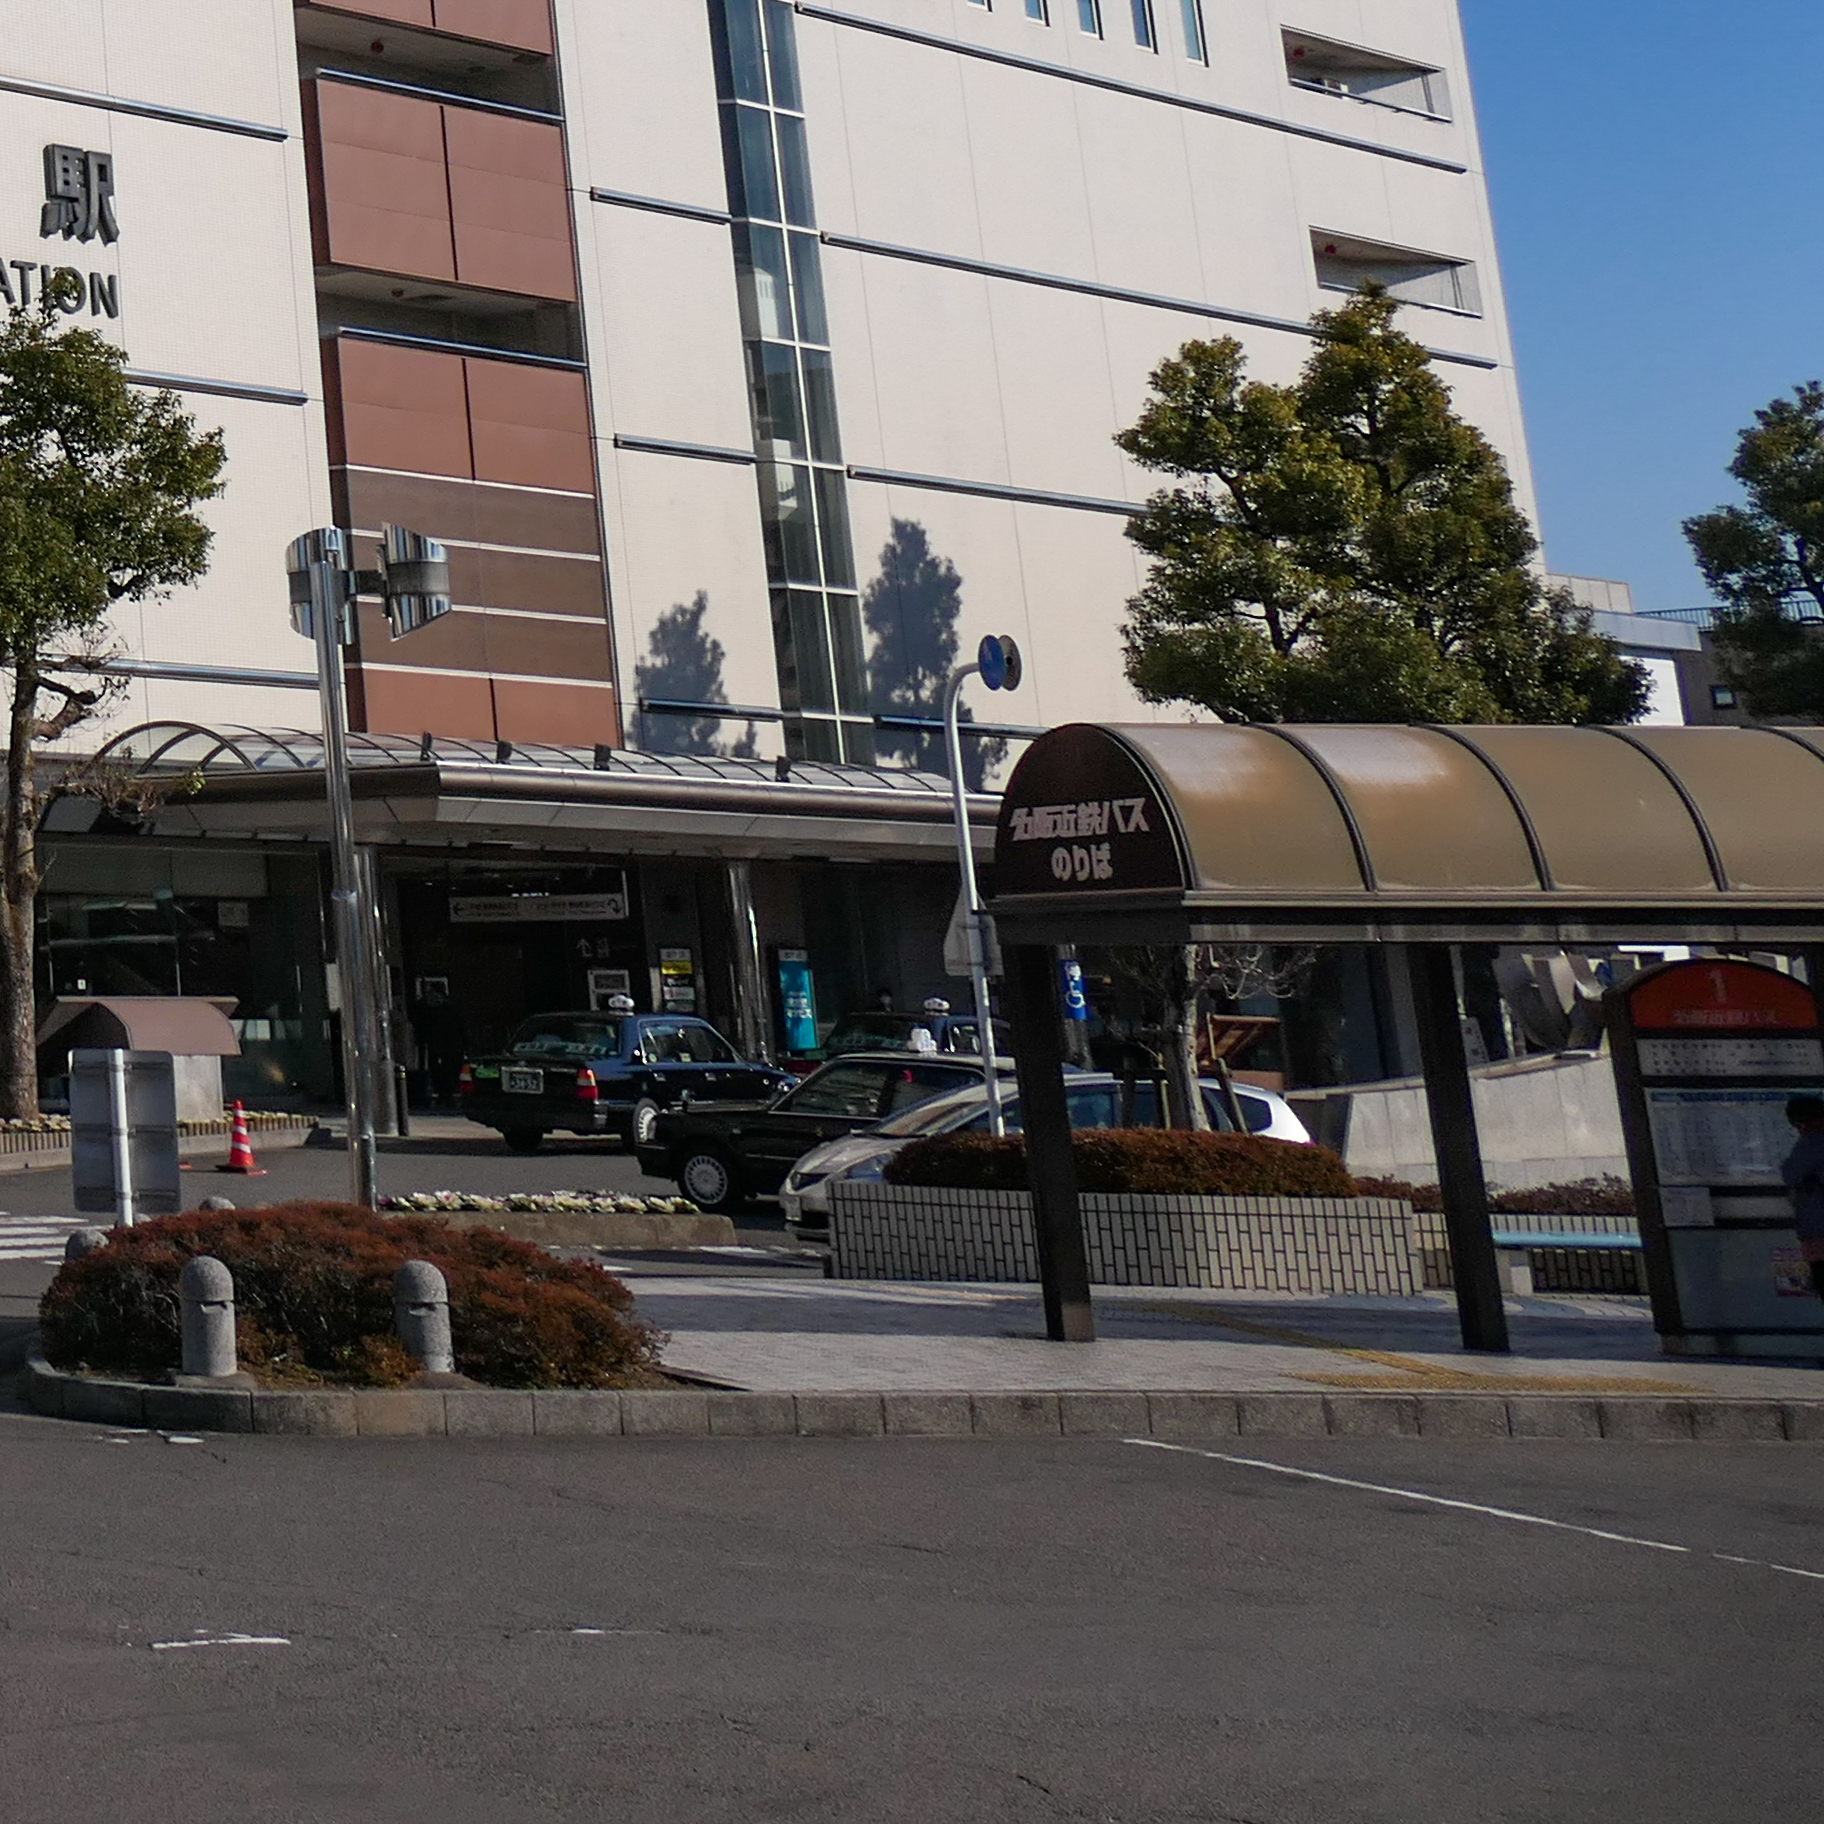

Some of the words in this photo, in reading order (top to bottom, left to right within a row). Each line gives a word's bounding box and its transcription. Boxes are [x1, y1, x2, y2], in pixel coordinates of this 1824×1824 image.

[1010, 797, 1150, 841] 名阪近鉄バス
[1051, 842, 1113, 881] のりば
